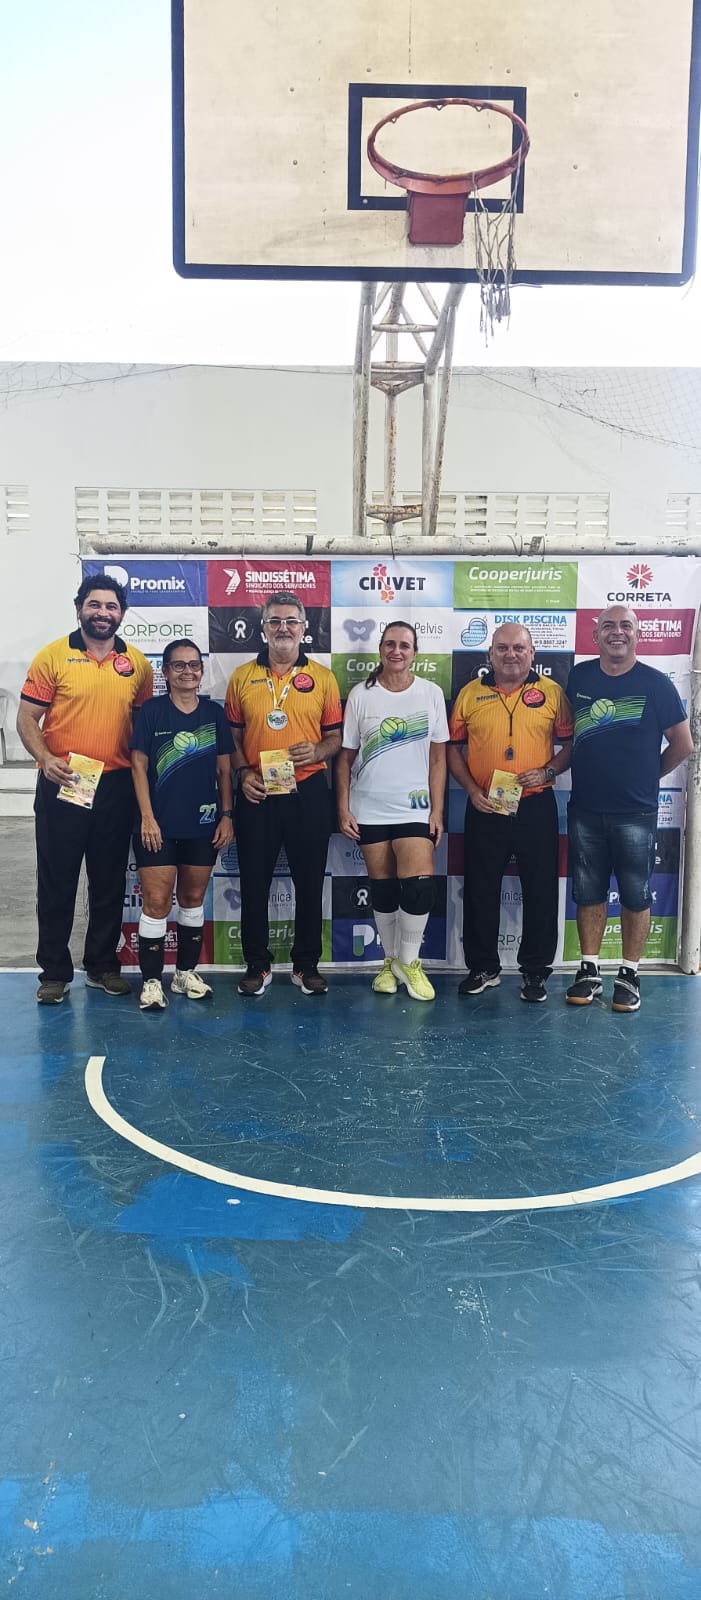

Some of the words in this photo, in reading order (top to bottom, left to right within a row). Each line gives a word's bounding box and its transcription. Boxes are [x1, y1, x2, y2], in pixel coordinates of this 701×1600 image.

[245, 569, 317, 583] SINDISSÉTIMA
[469, 566, 563, 584] Cooperjuris
[130, 576, 186, 590] Promix
[359, 576, 427, 591] CINVET
[607, 592, 672, 602] CORRETA
[494, 615, 521, 624] DISK
[523, 615, 567, 624] PISCINA
[638, 618, 682, 631] ISSÉTIMA
[414, 622, 444, 634] Pelvis
[408, 789, 429, 809] 10
[199, 803, 217, 824] 27
